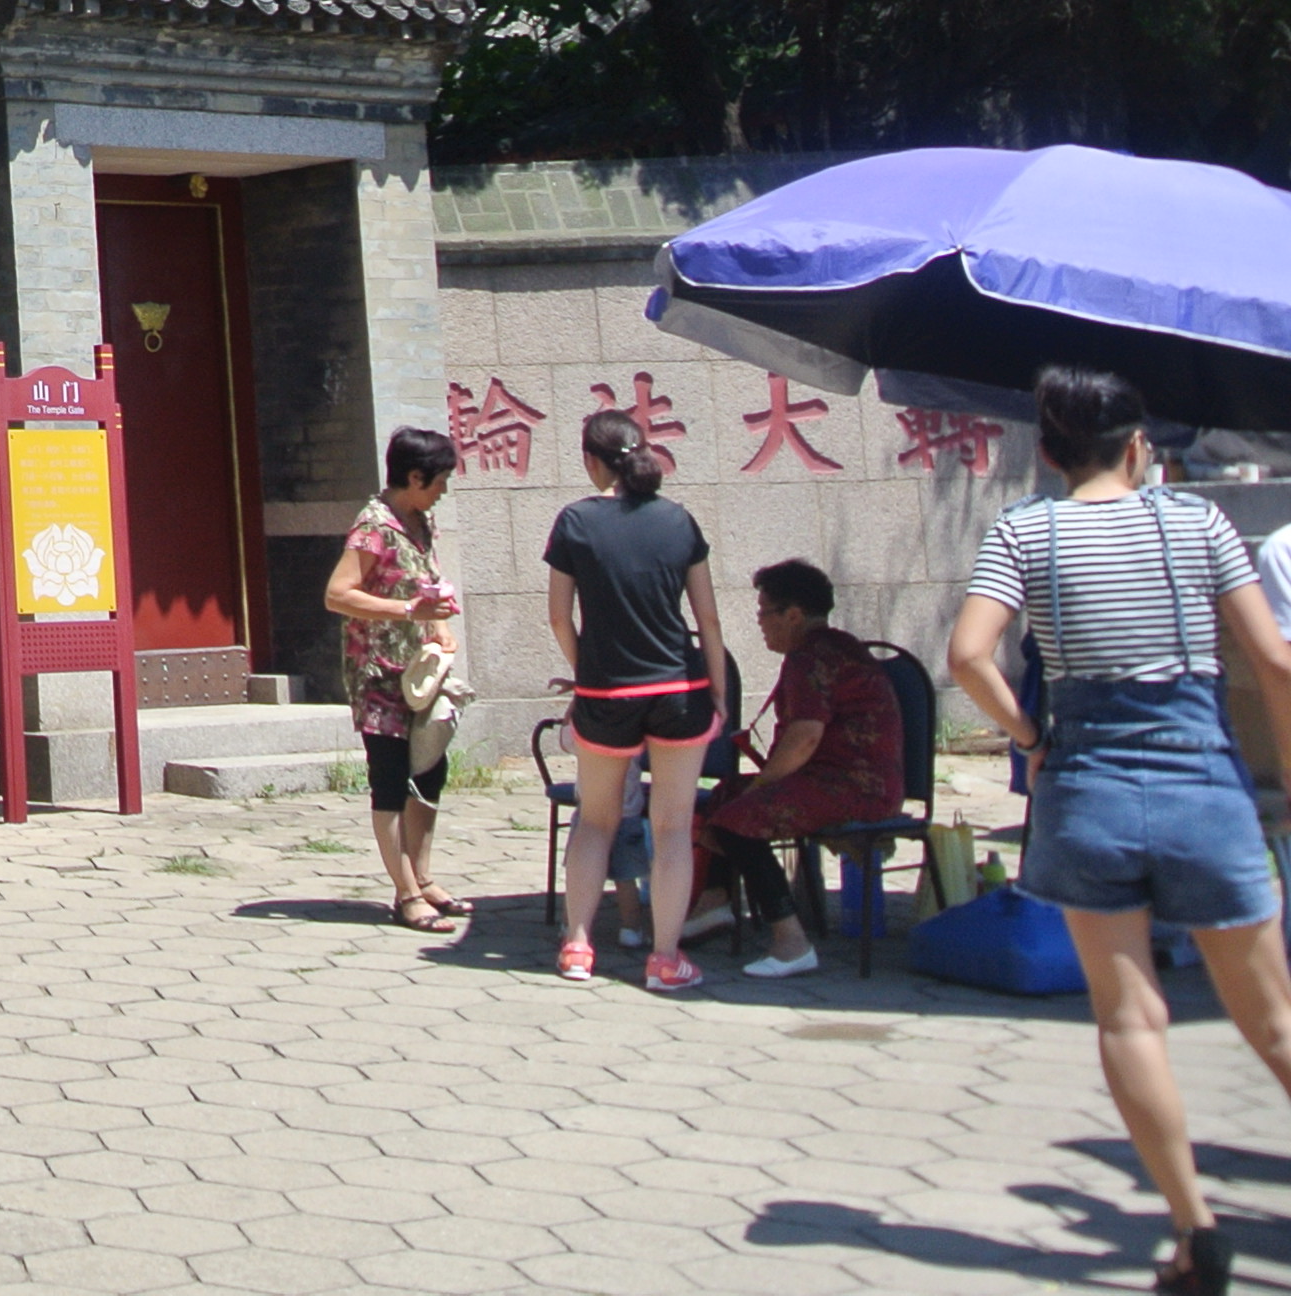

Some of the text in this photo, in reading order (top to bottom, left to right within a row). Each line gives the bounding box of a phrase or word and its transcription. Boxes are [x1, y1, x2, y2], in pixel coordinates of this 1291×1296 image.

[33, 380, 79, 403] 山门
[27, 404, 85, 415] The Temple Gate
